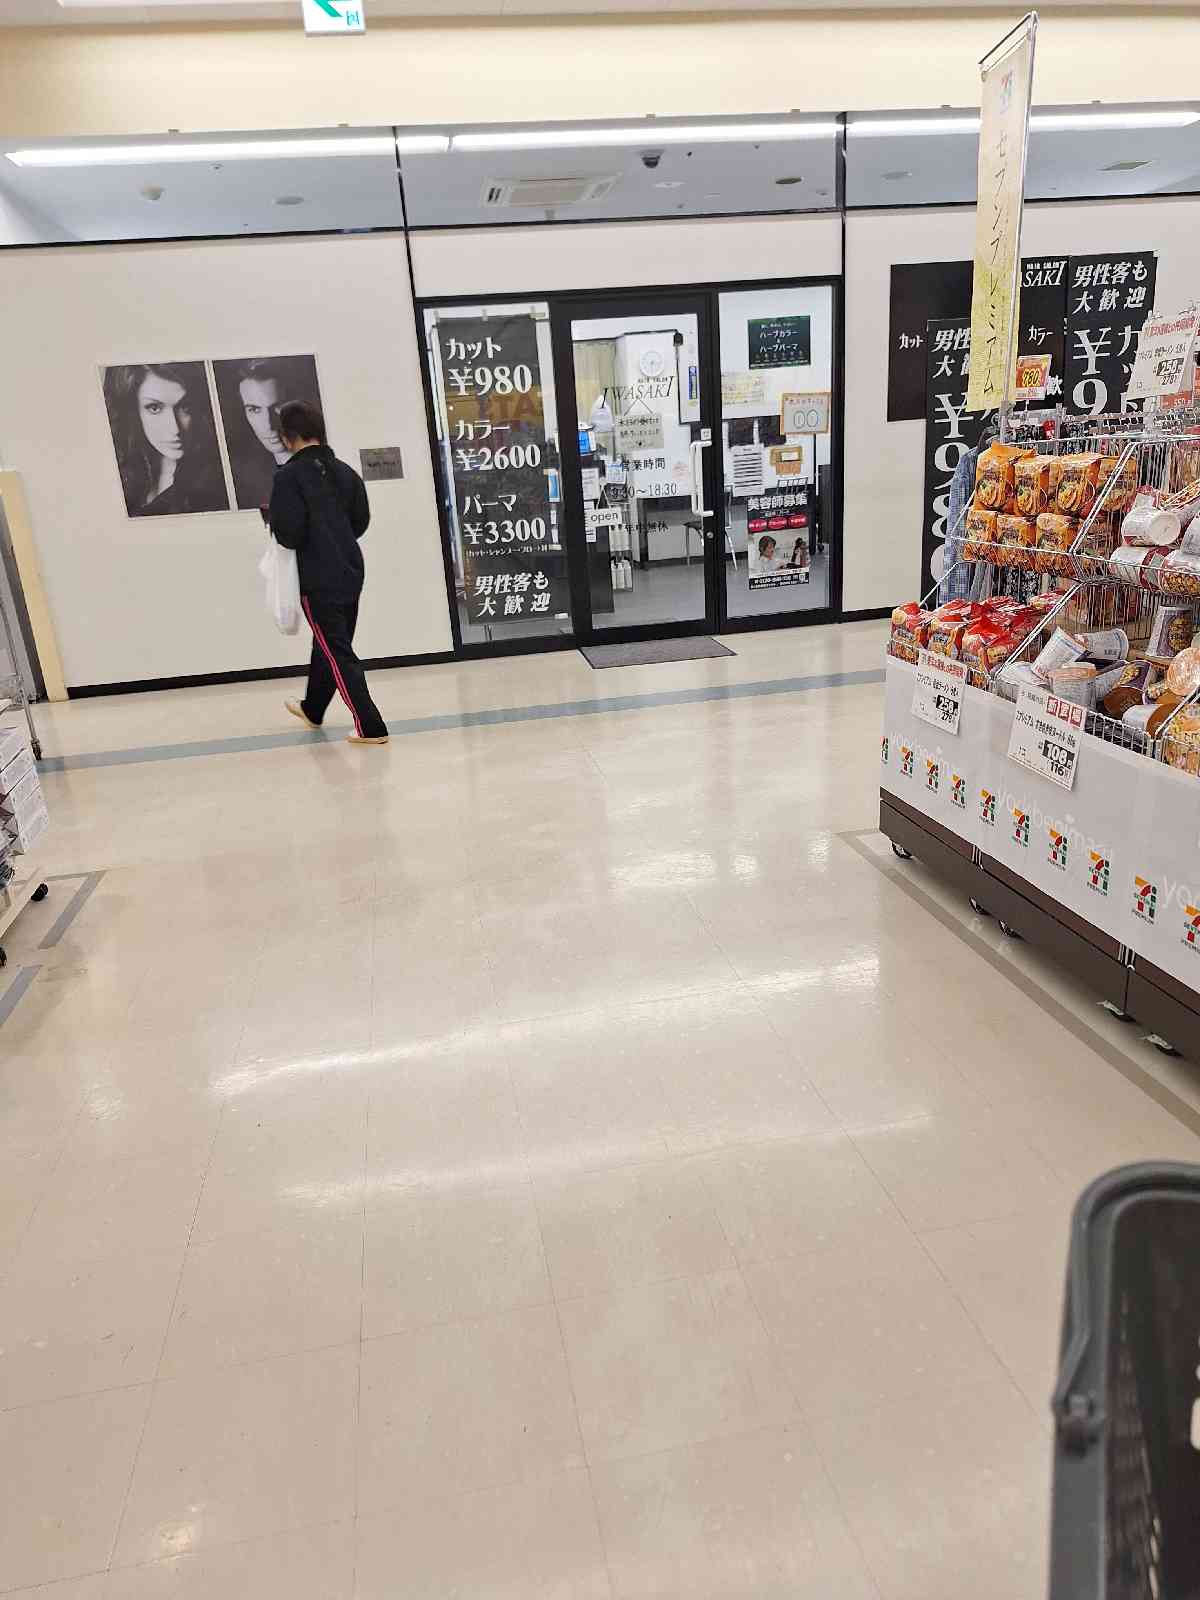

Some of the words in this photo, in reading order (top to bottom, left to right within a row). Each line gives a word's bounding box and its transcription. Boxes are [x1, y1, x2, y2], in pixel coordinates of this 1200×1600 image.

[1022, 260, 1067, 288] SAKI
[1071, 260, 1148, 288] 男性客も
[898, 332, 924, 350] カット
[1028, 324, 1054, 346] カラー
[445, 336, 502, 361] カット
[448, 364, 533, 396] ¥980
[599, 375, 675, 410] IWASAKI
[454, 419, 511, 441] カラー
[455, 444, 541, 471] ¥2600
[621, 457, 666, 473] 営業時間
[463, 494, 517, 516] パーマ
[747, 493, 808, 512] 美容師募集
[590, 511, 618, 524] open
[463, 517, 546, 545] ¥3300
[473, 571, 549, 597] 男性客も
